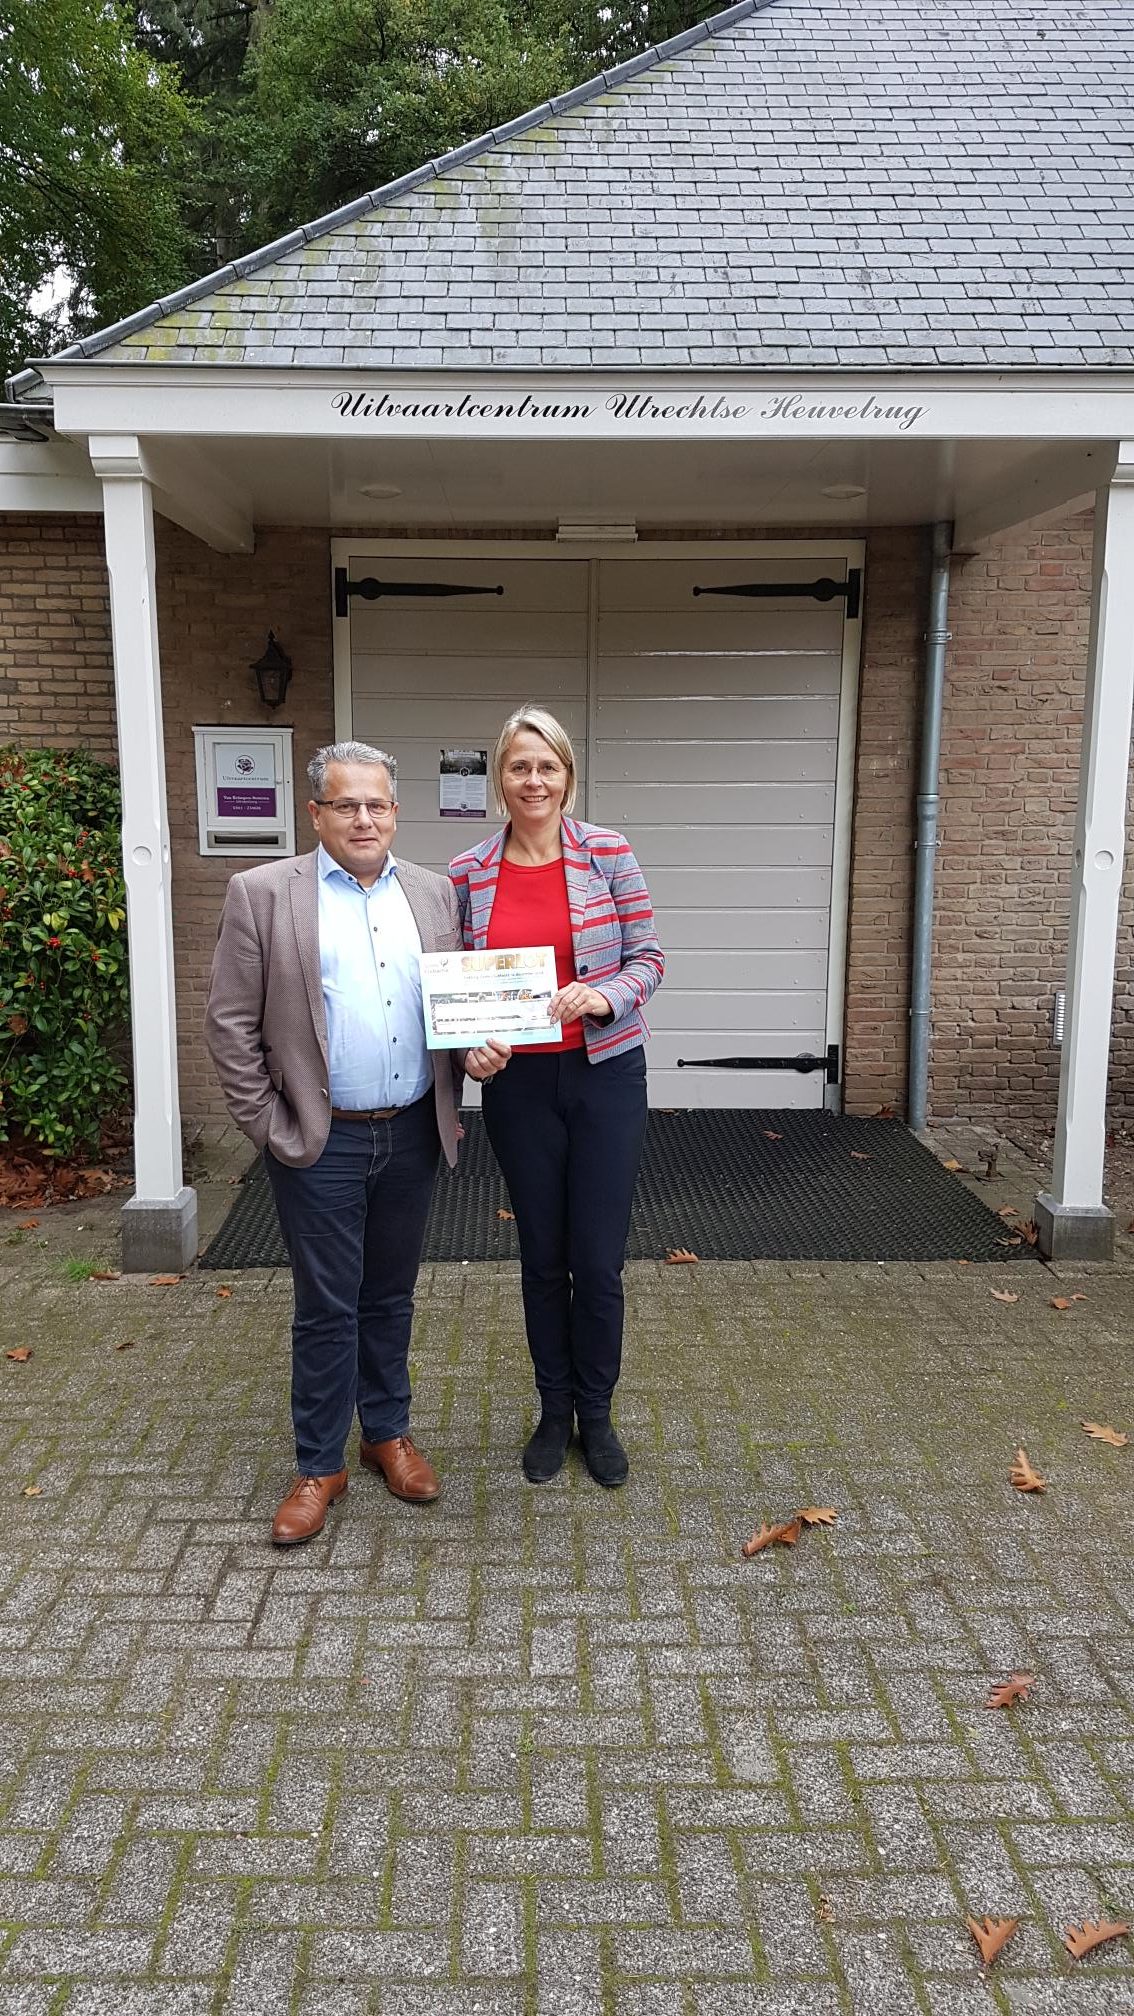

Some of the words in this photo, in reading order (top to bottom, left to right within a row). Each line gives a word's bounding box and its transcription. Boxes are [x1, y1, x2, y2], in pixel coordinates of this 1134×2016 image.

[331, 391, 598, 418] Uitvaartcentrum
[605, 393, 752, 419] Utrechtse
[760, 394, 931, 430] Heuvelrug
[461, 952, 548, 973] SUPERLOT
